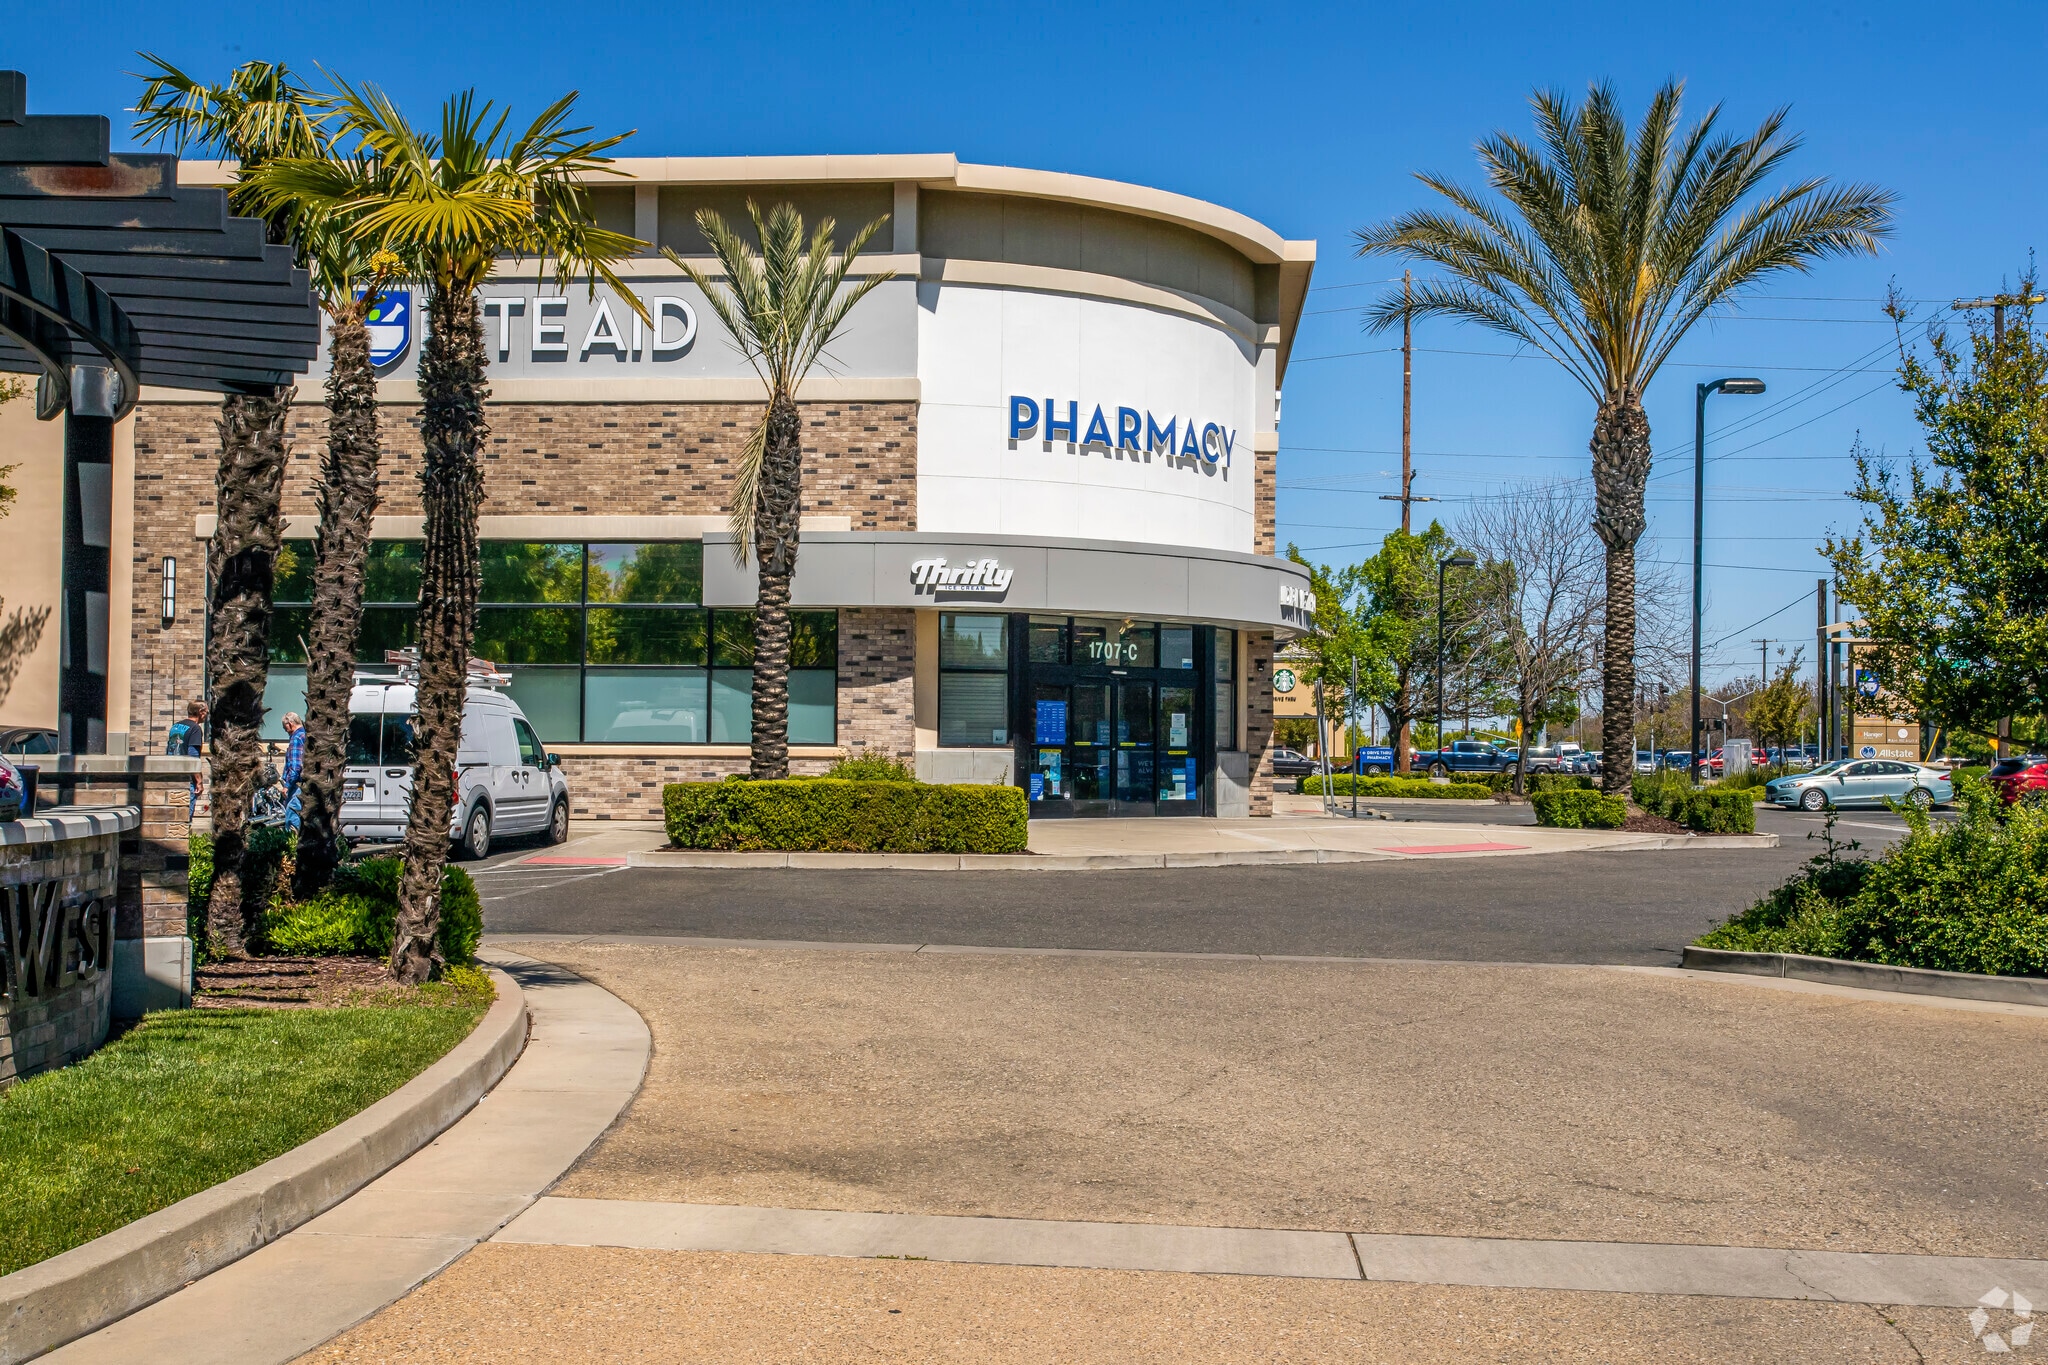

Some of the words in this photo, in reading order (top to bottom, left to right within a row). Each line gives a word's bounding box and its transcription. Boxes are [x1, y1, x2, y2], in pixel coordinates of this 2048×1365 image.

[420, 296, 569, 352] TE
[580, 295, 698, 352] AID
[1008, 395, 1236, 468] PHARMACY
[911, 557, 1014, 592] Thrifty
[1088, 641, 1138, 661] 1707-C
[1879, 749, 1914, 758] Allstate
